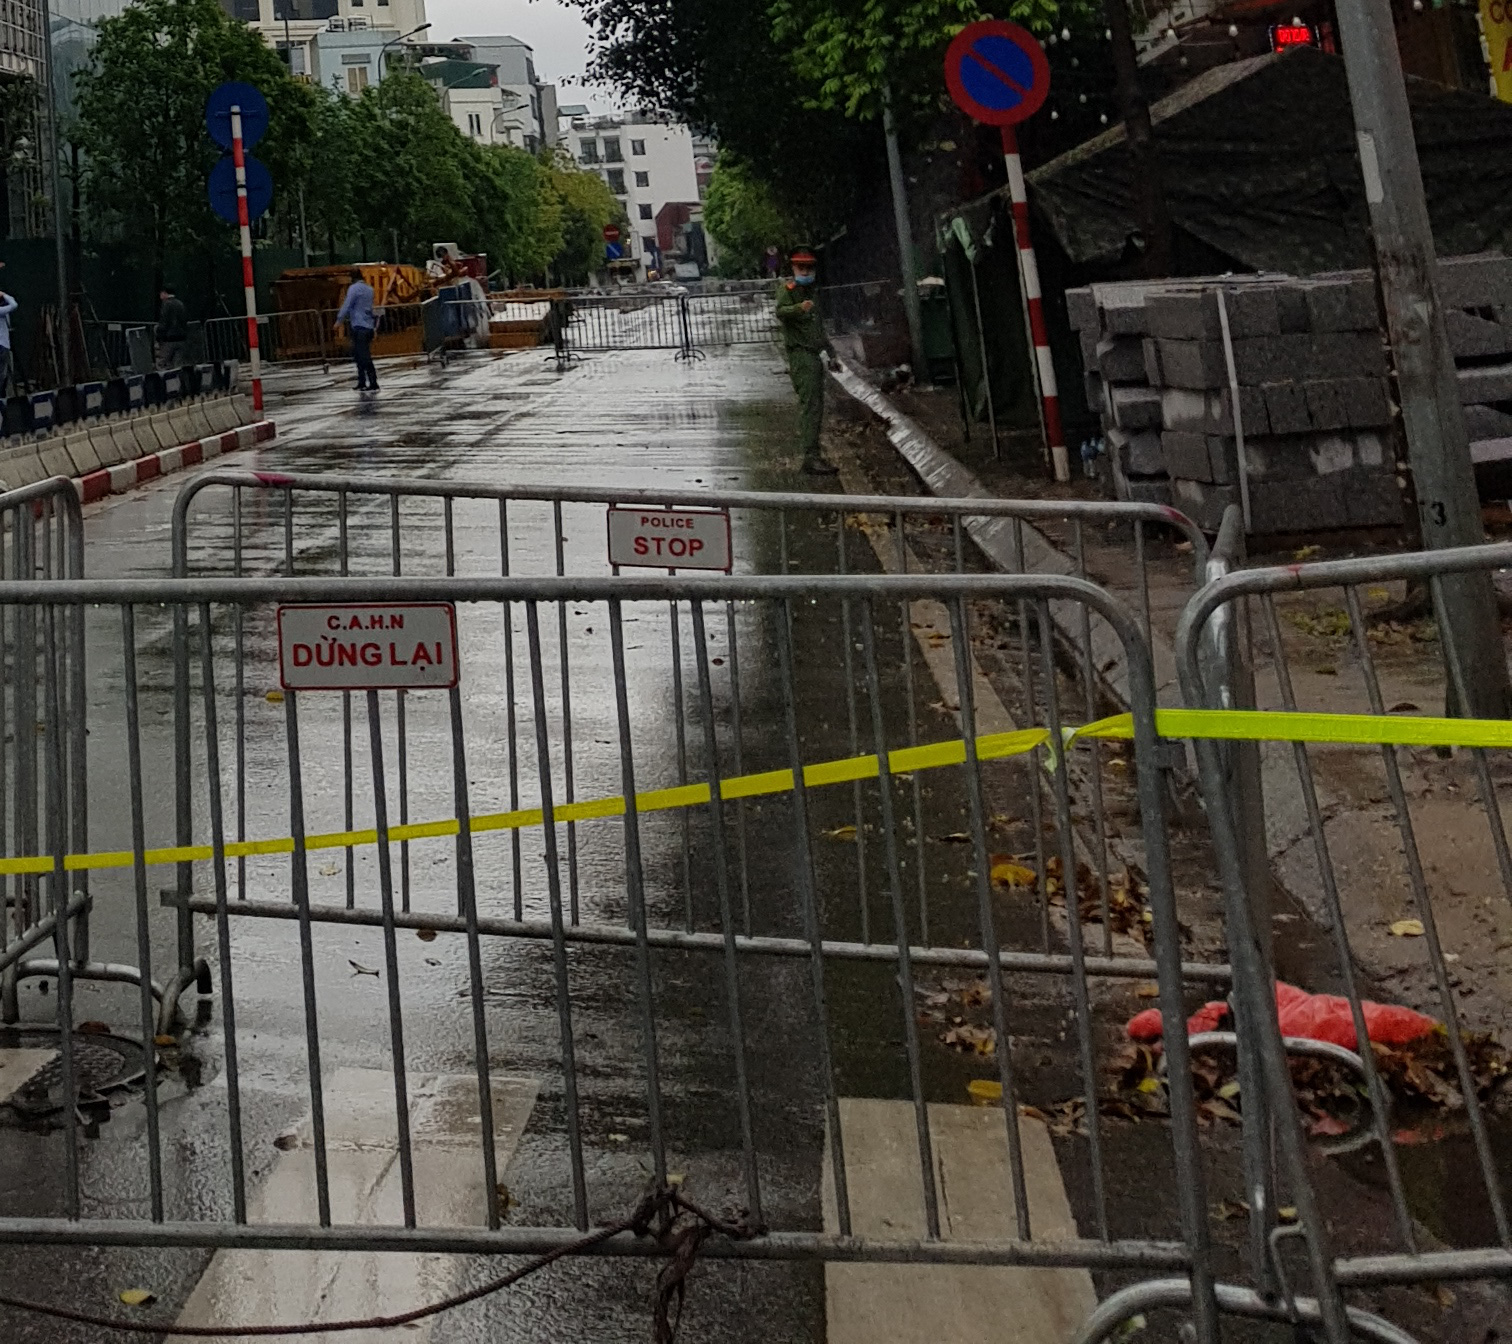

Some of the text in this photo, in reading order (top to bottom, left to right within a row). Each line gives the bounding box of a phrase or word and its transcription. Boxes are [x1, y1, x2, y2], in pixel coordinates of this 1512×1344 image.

[641, 516, 695, 529] POLICE
[633, 536, 704, 557] STOP
[327, 614, 404, 631] C.A.H.N
[292, 634, 443, 672] DỪNG LẠI
